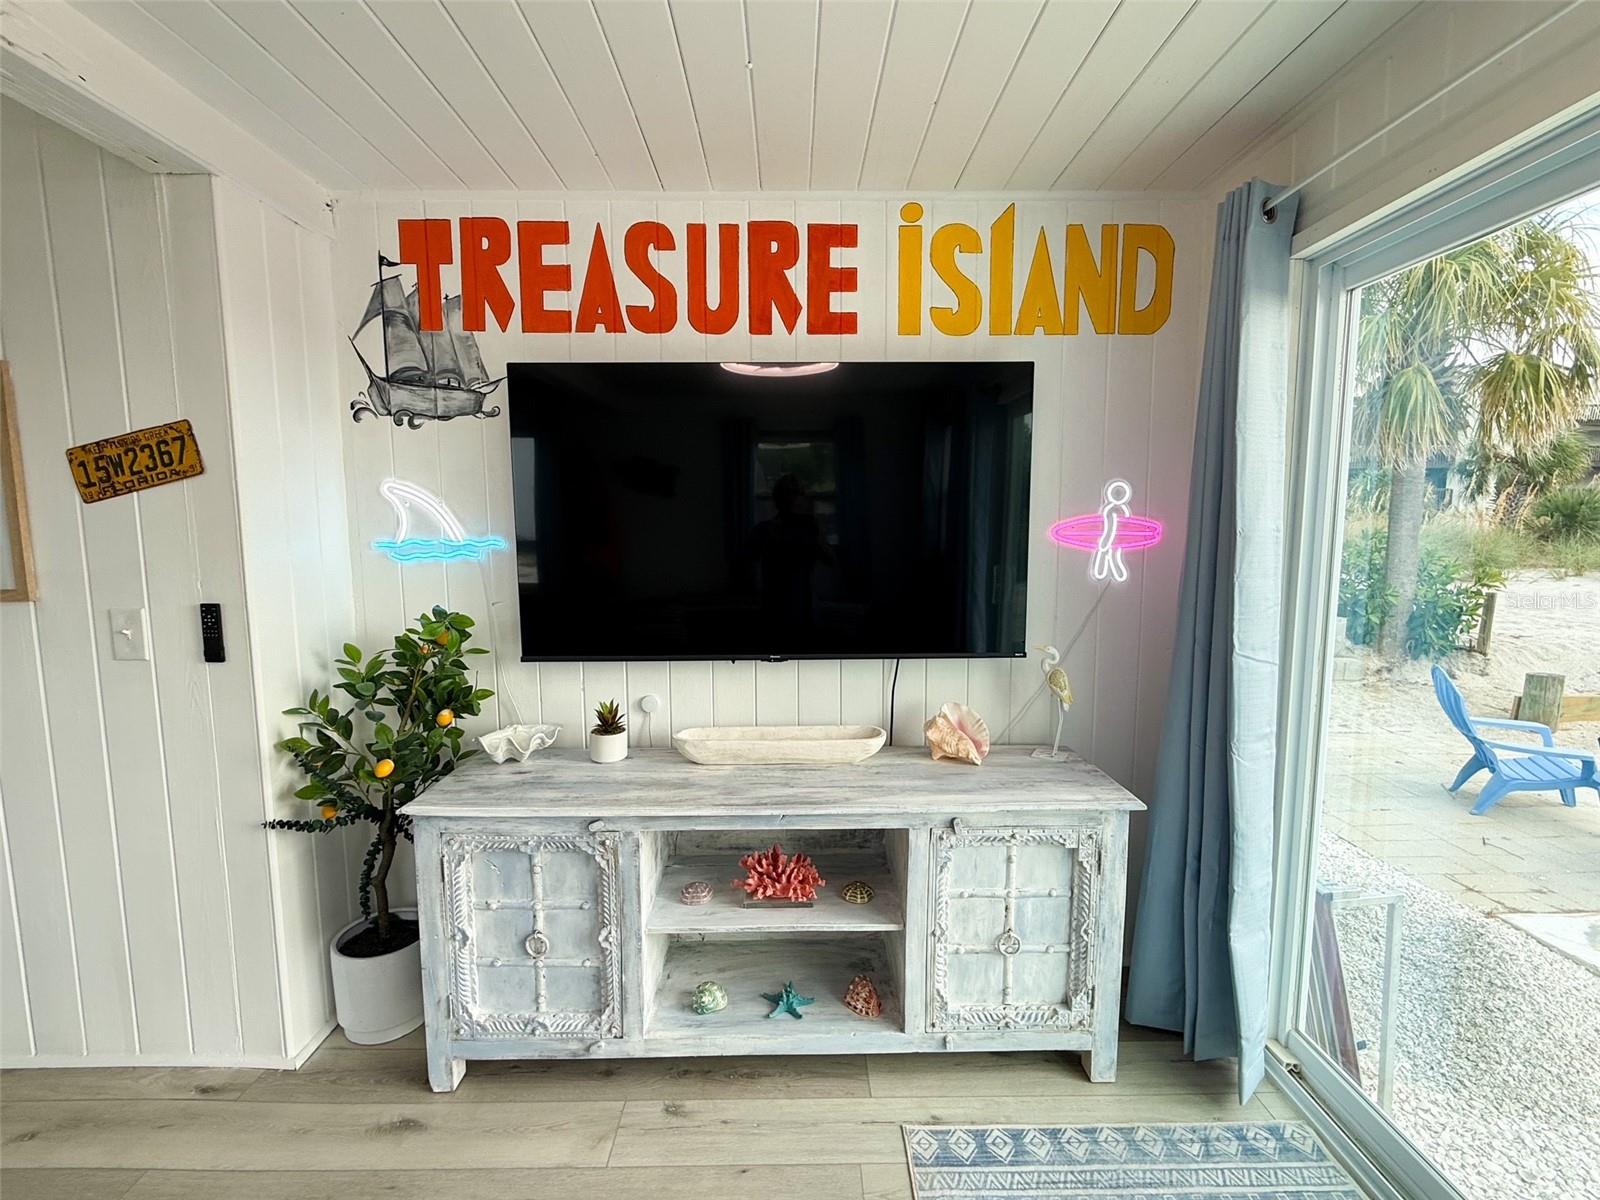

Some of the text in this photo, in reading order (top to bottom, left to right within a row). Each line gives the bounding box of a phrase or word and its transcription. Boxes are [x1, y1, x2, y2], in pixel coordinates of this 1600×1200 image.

[398, 217, 858, 336] TREASURE
[77, 433, 186, 489] 15W2367
[101, 467, 182, 497] FLORIDA
